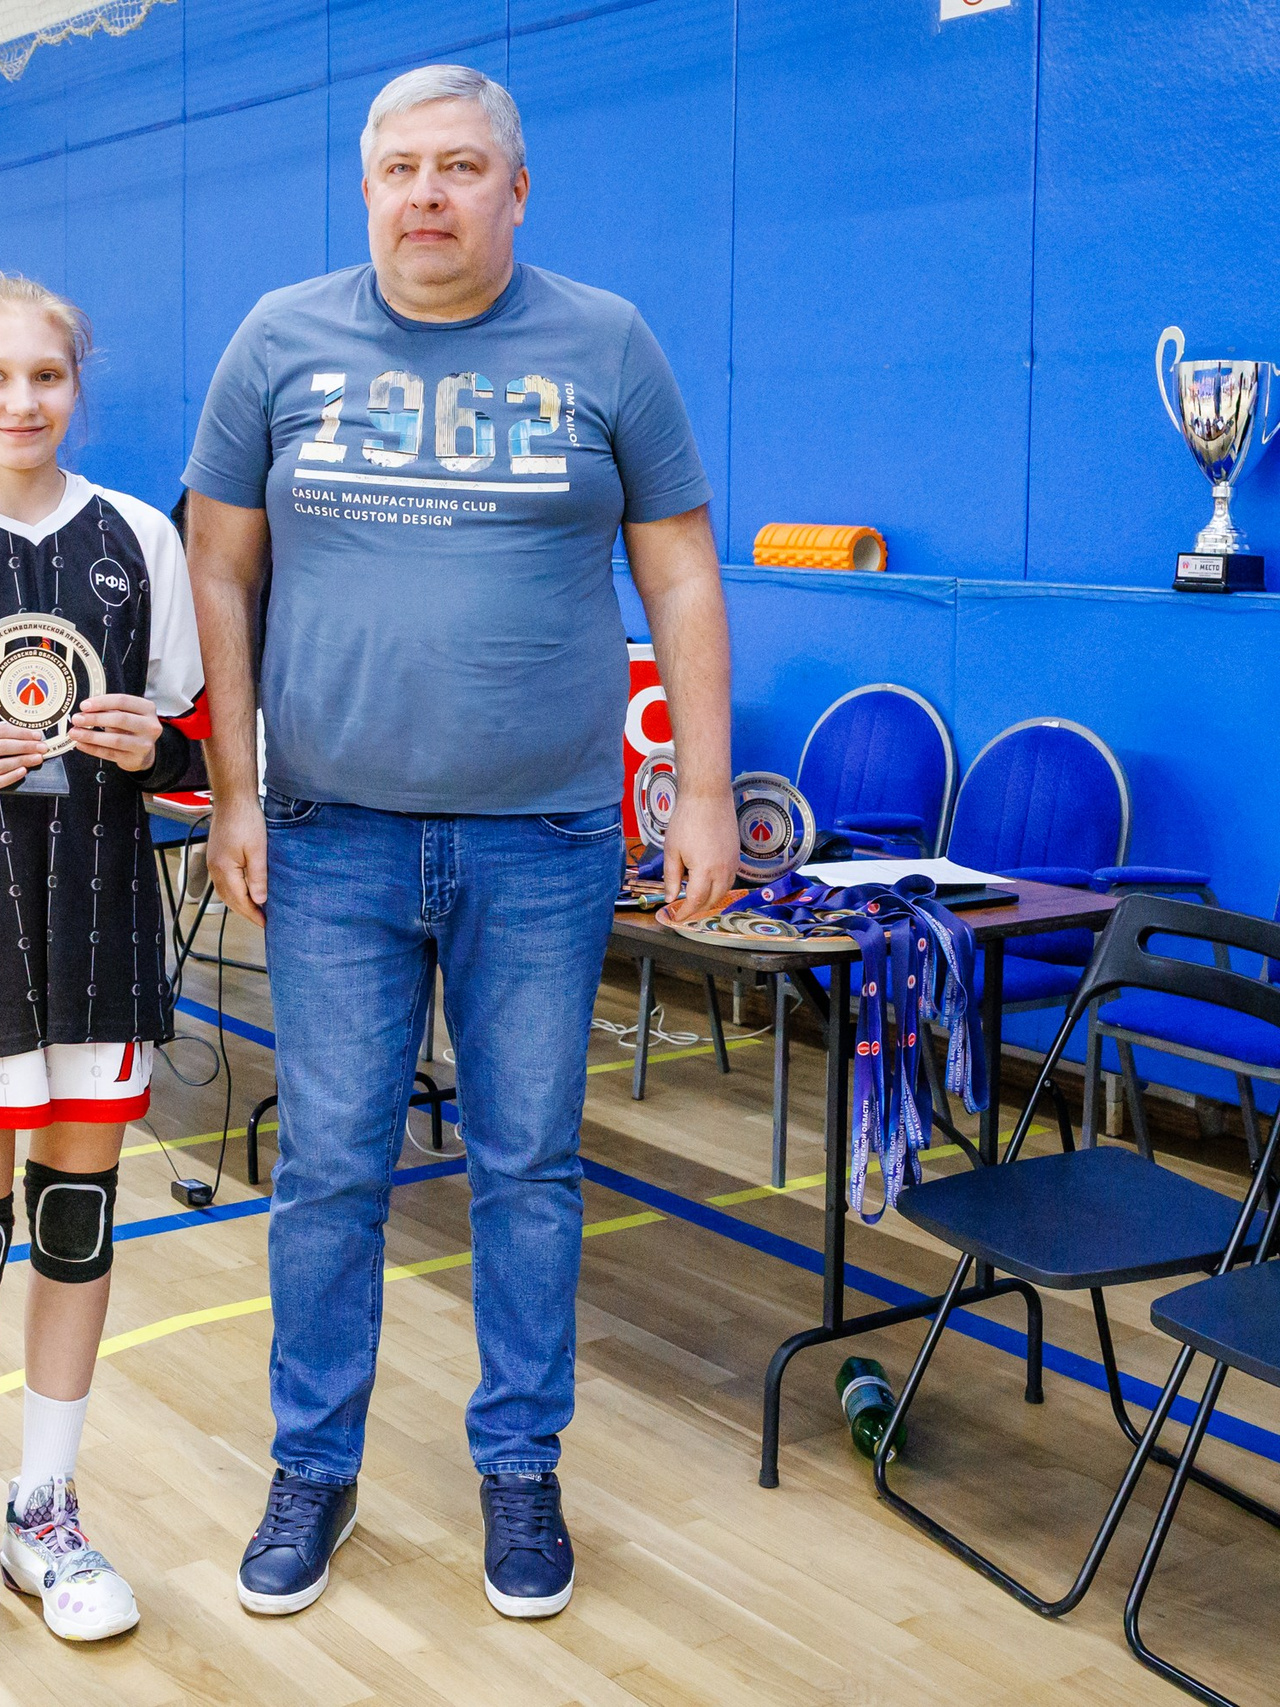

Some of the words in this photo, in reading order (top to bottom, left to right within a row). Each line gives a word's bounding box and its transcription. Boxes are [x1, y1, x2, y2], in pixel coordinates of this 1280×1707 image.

[564, 382, 575, 406] TOM
[298, 369, 567, 475] 1962
[291, 487, 337, 501] CASUAL
[341, 492, 459, 511] MANUFACTURING
[462, 500, 497, 513] CLUB
[293, 503, 340, 519] CLASSIC
[344, 509, 398, 524] CUSTOM
[402, 514, 453, 527] DESIGN
[95, 573, 127, 592] РФБ
[3, 623, 65, 636] СИМВОЛИЧЕСКОЙ
[65, 632, 90, 658] ПЯТЕРКИ
[57, 739, 73, 749] МОЛО
